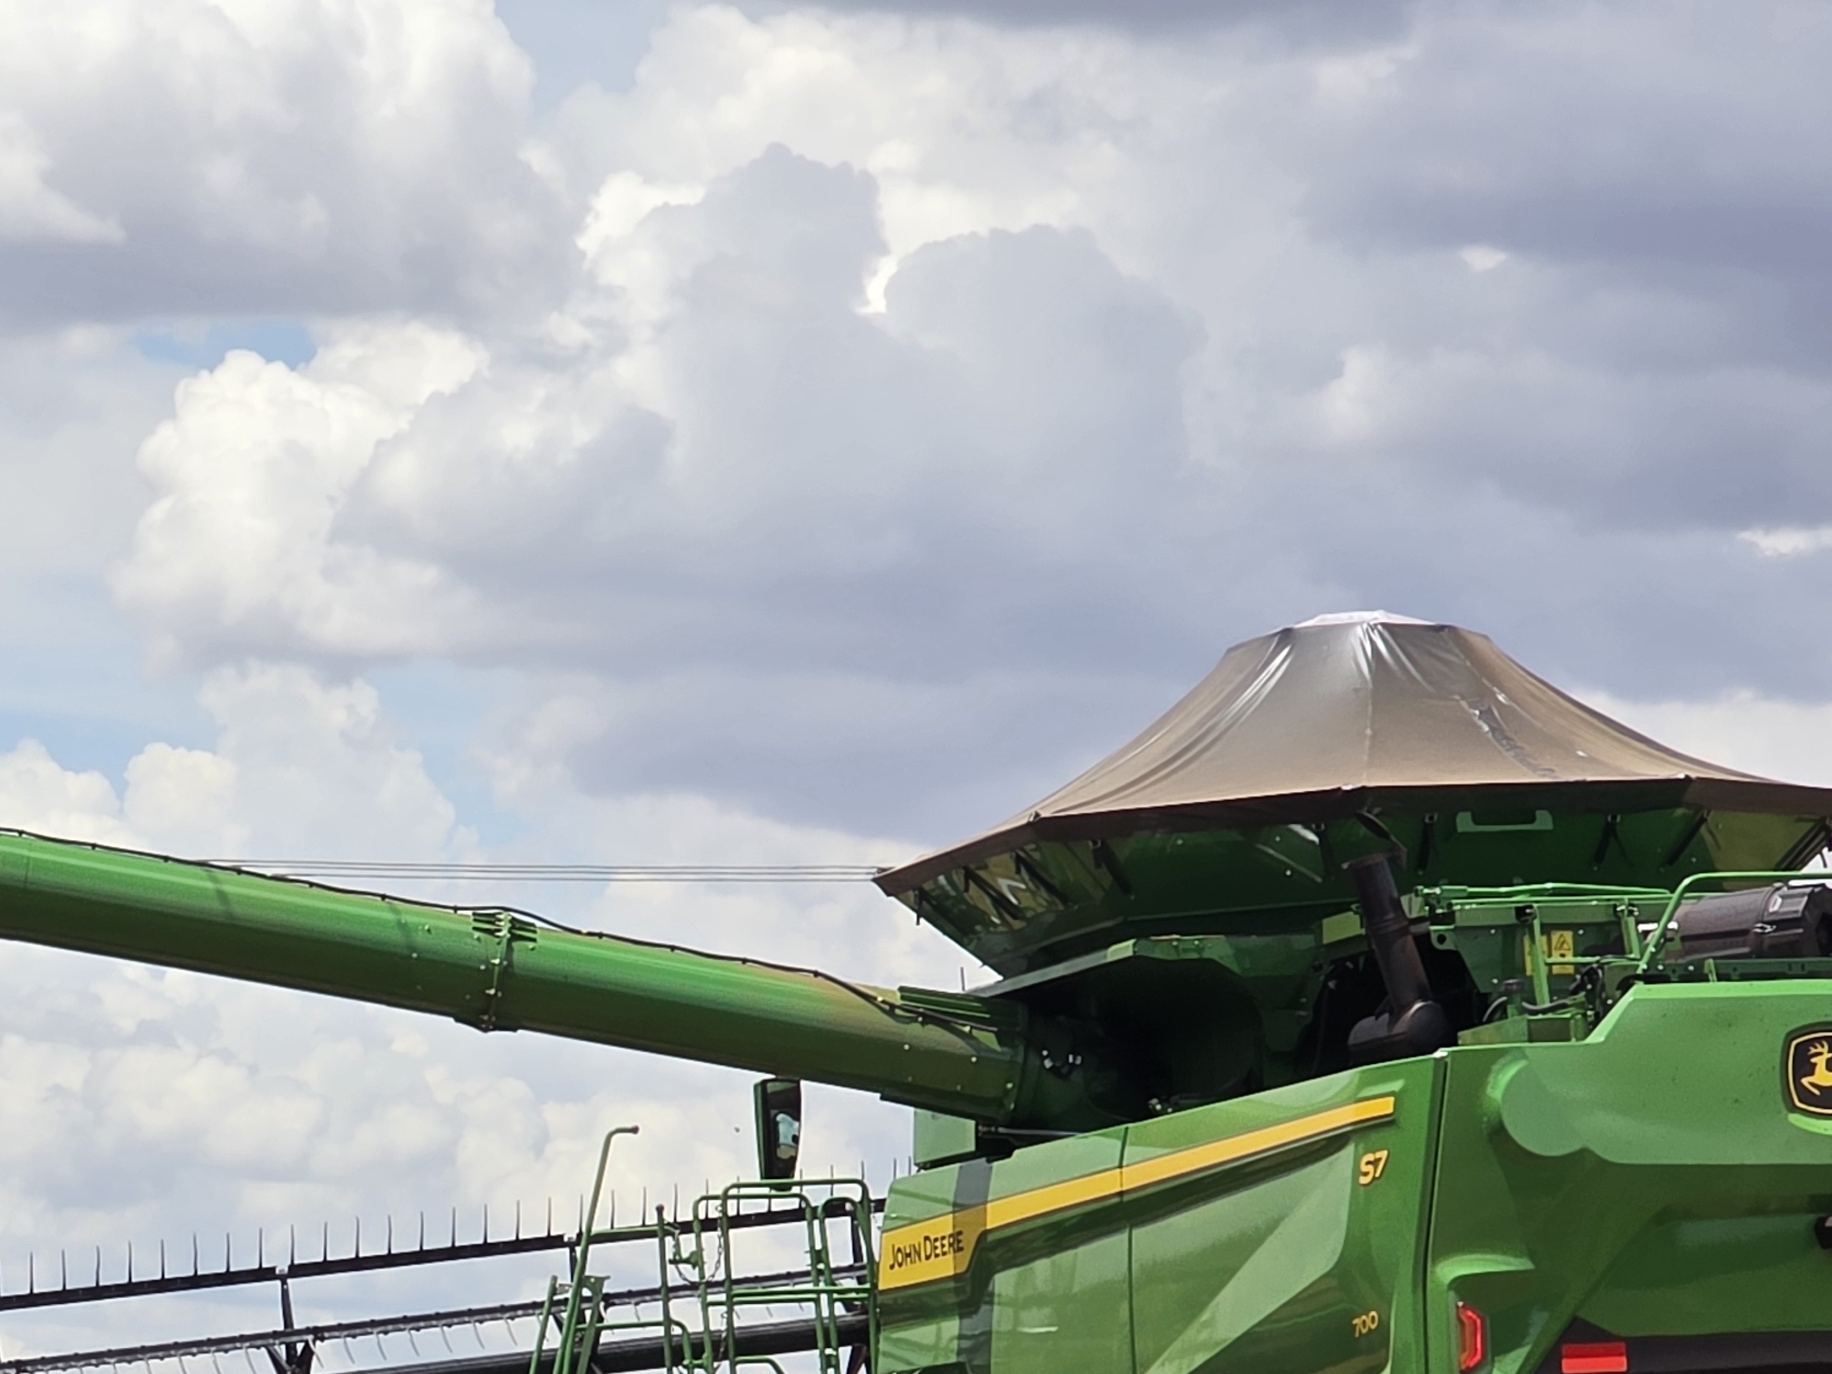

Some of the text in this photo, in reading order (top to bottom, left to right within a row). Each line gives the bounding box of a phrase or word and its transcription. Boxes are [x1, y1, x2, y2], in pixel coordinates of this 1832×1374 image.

[1358, 1149, 1388, 1185] S7
[889, 1230, 965, 1270] JOHN DEERE
[1351, 1310, 1379, 1338] 700
